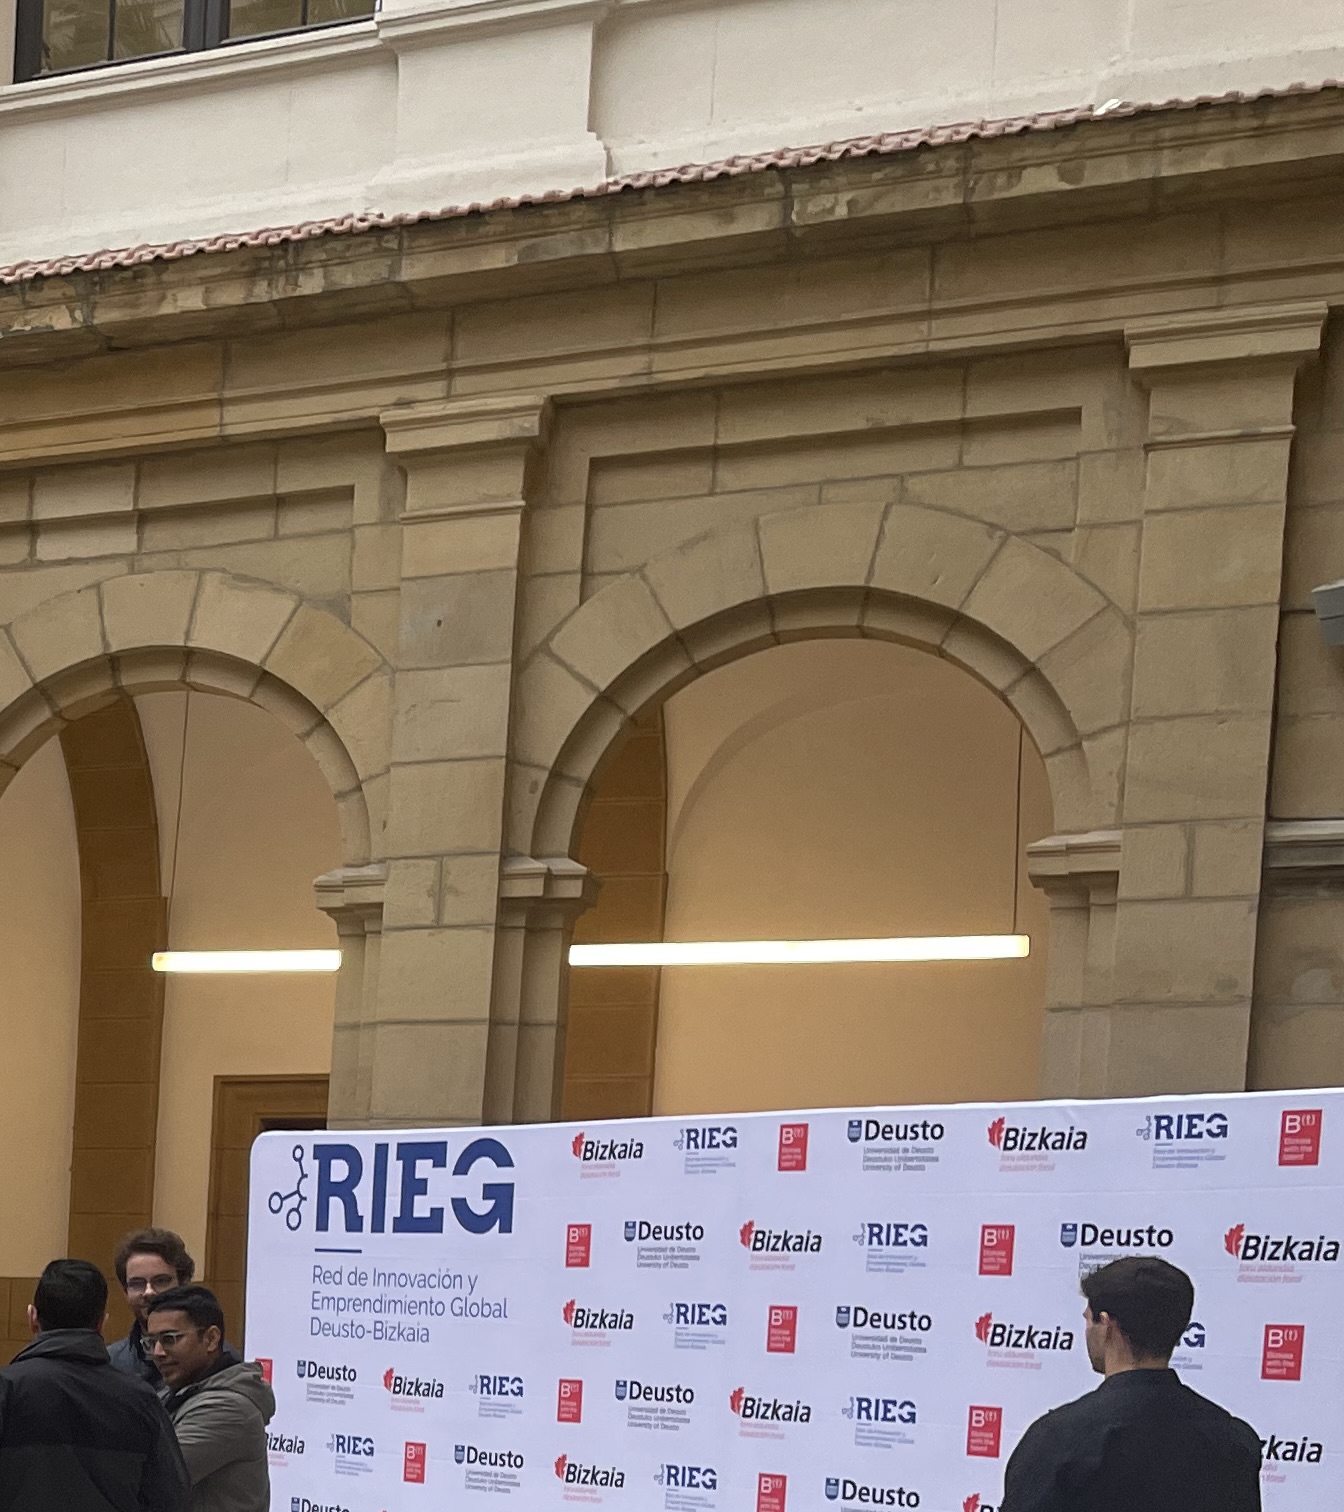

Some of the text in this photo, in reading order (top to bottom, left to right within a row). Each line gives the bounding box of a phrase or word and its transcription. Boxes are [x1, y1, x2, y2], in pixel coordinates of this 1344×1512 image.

[865, 1120, 945, 1141] Deusto
[1154, 1113, 1228, 1140] RIEG
[1285, 1114, 1315, 1133] B(t)
[582, 1138, 644, 1162] Bizkaia
[685, 1126, 738, 1150] RIEG
[1003, 1126, 1088, 1150] Bizkaia
[312, 1137, 515, 1235] RIEG
[638, 1221, 704, 1241] Deusto
[752, 1229, 822, 1253] Bizkaia
[868, 1223, 928, 1247] RIEG
[1081, 1224, 1174, 1247] Deusto
[1241, 1235, 1340, 1261] Bizkaia
[313, 1265, 478, 1296] Red de Innovación y
[311, 1291, 508, 1319] Emprendimiento Global
[675, 1303, 727, 1326] RIEG
[310, 1317, 430, 1344] Deusto-Bizkaia
[573, 1308, 634, 1330] Bizkaia
[853, 1307, 932, 1332] Deusto
[990, 1323, 1075, 1351] Bizkaia
[1267, 1328, 1298, 1349] B(t)
[307, 1361, 357, 1382] Deusto
[393, 1376, 445, 1399] Bizkaia
[480, 1375, 524, 1398] RIEG
[629, 1381, 694, 1404] Deusto
[742, 1397, 812, 1424] Bizkaia
[856, 1397, 917, 1424] RIEG
[266, 1432, 305, 1455] izkaia
[335, 1434, 375, 1457] RIEG
[467, 1446, 524, 1469] Deusto
[565, 1463, 626, 1488] Bizkaia
[666, 1465, 717, 1490] RIEG
[842, 1479, 920, 1508] Deusto
